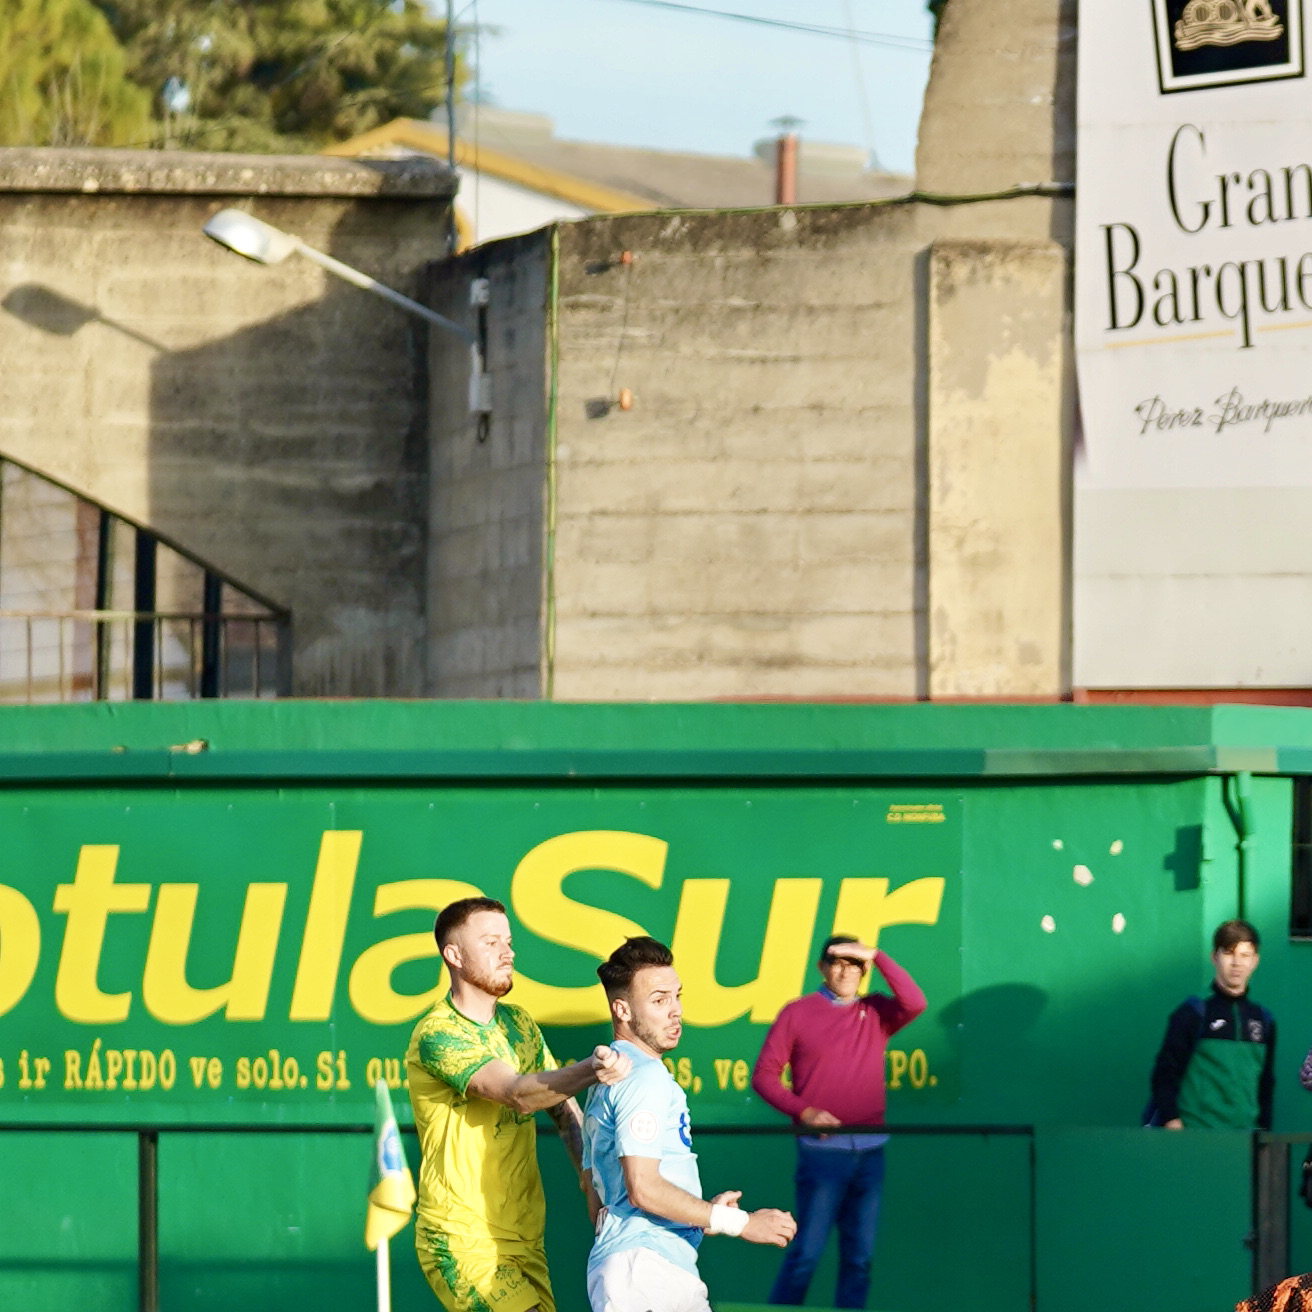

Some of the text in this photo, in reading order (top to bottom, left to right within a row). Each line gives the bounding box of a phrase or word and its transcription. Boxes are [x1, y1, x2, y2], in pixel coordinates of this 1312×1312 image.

[18, 1048, 51, 1090] ir
[64, 1037, 177, 1091] RÁPIDO
[189, 1055, 224, 1090] ve
[235, 1049, 309, 1091] solo.
[314, 1049, 352, 1090] Si
[714, 1057, 750, 1091] ve
